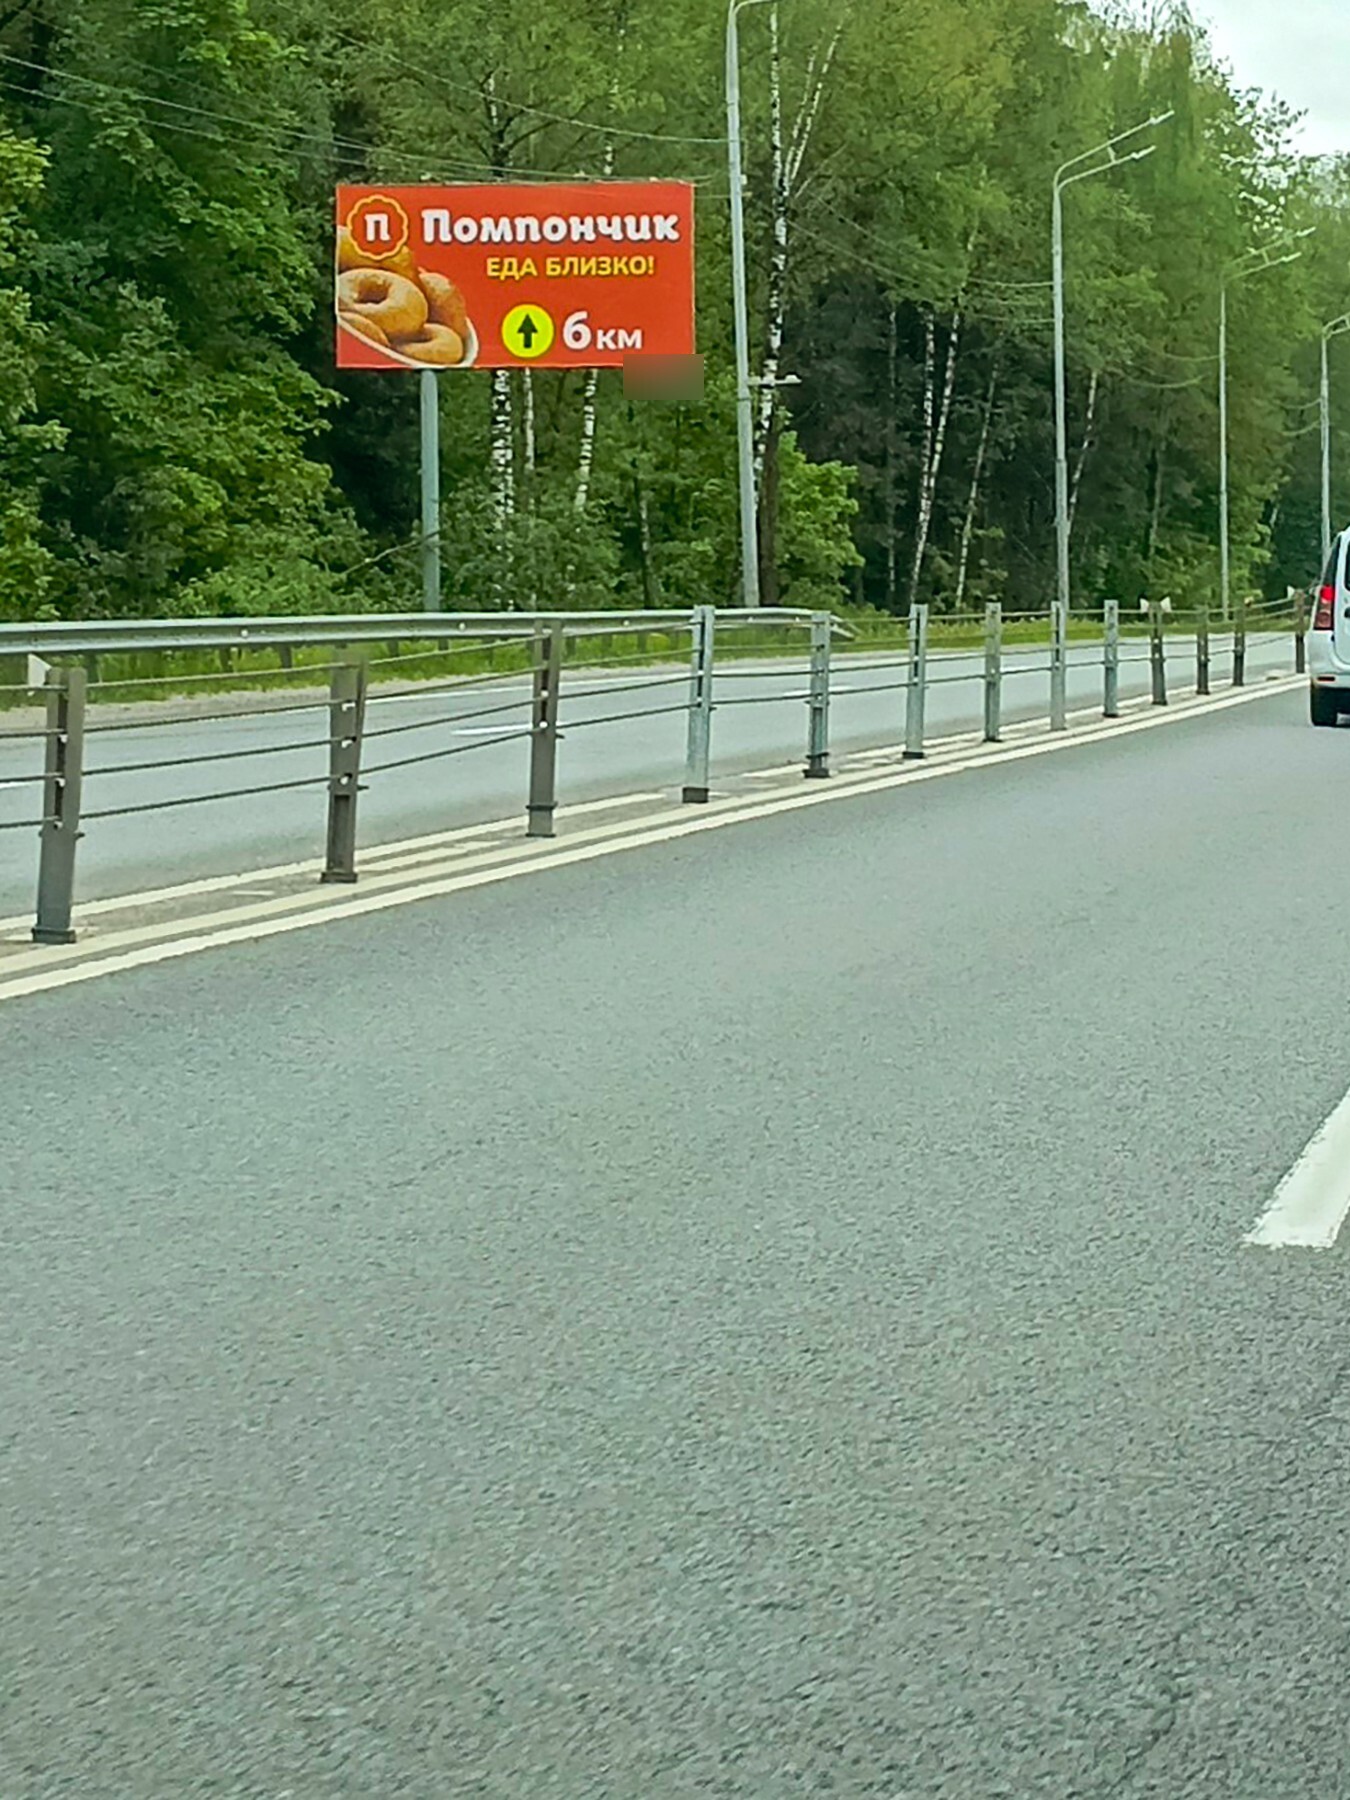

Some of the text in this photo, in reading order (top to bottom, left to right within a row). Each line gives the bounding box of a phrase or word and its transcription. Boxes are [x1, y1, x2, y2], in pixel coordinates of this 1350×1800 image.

[364, 213, 391, 242] П
[421, 208, 680, 243] Помпончик
[486, 255, 655, 281] ЕДА БЛИЗКО!
[562, 310, 592, 350] 6
